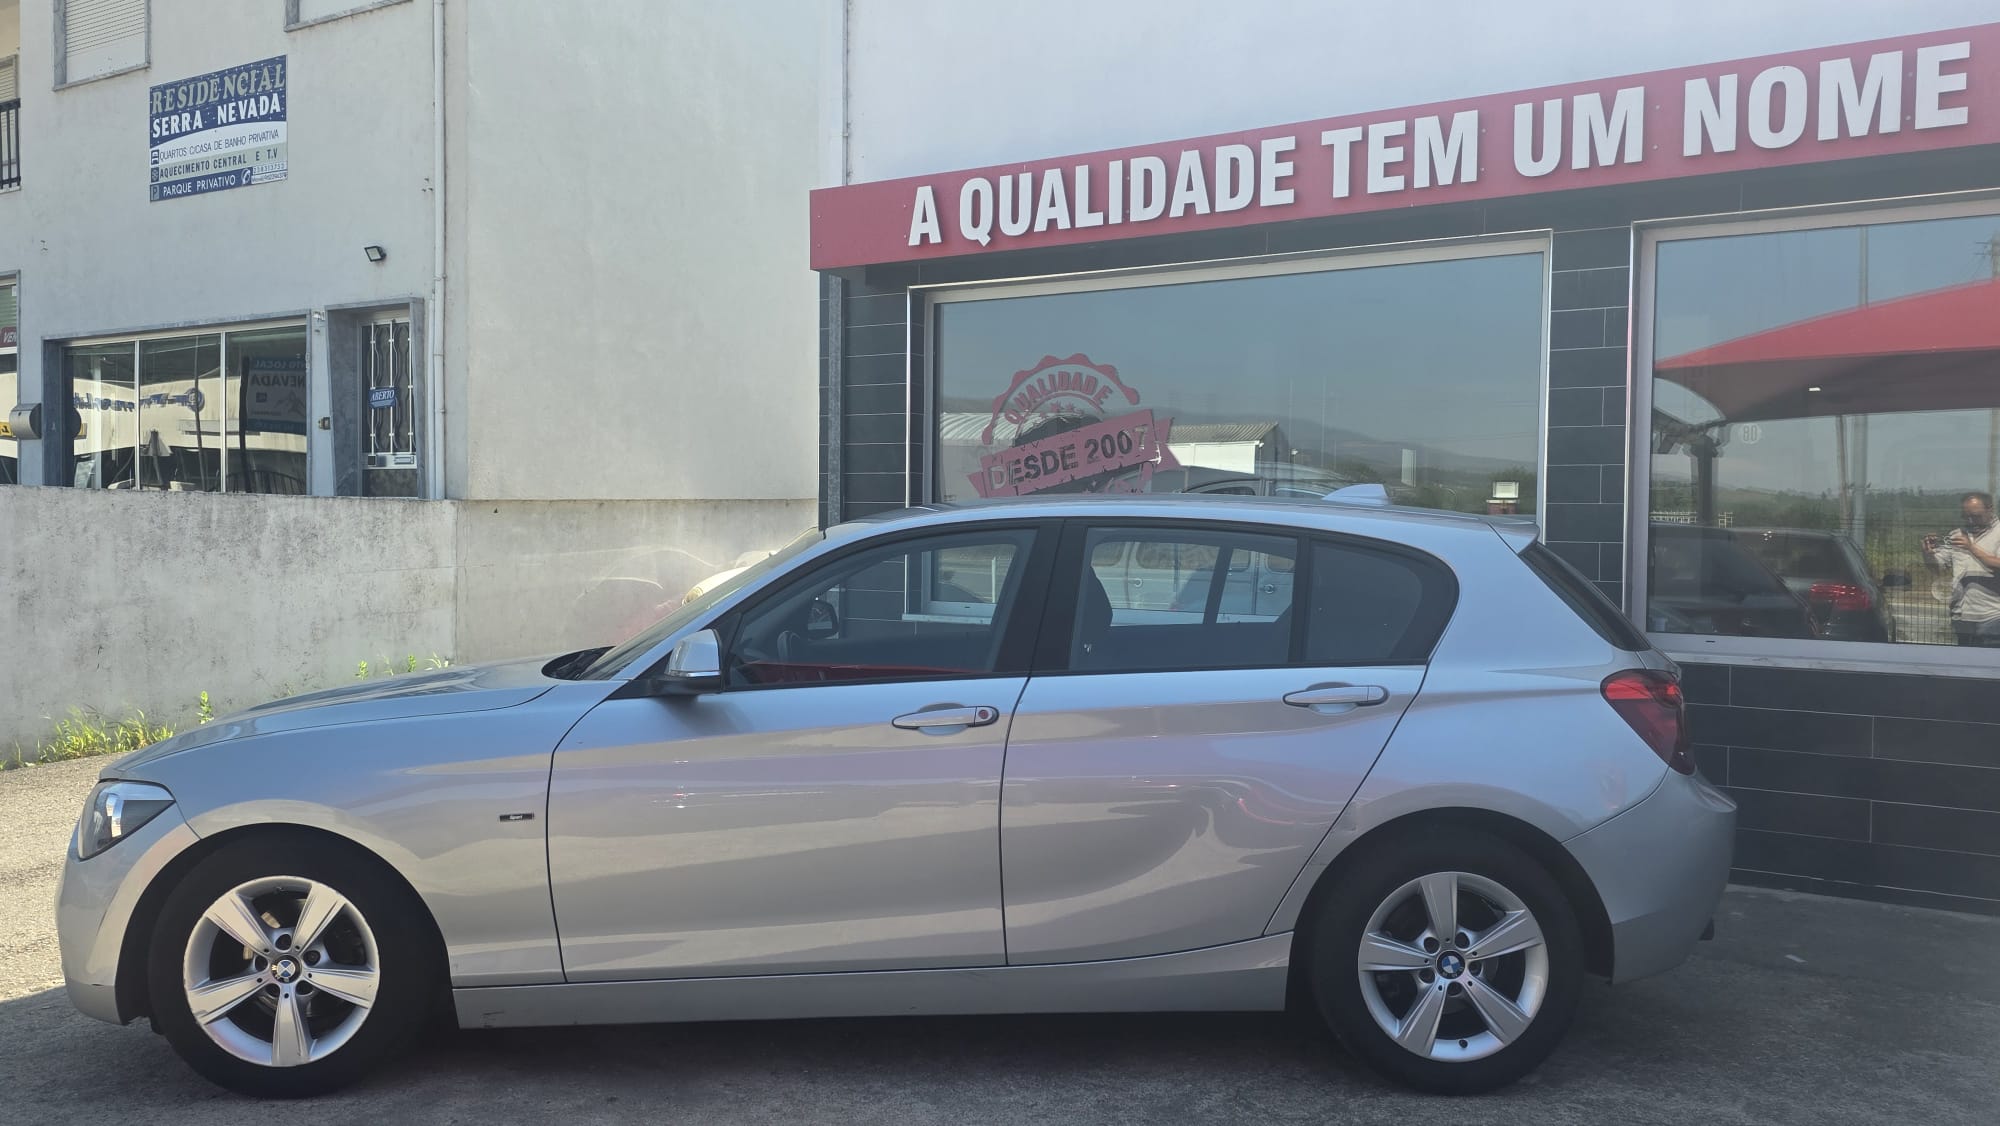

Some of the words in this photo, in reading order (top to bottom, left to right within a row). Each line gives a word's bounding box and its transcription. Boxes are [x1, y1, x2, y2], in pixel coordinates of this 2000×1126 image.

[152, 64, 285, 113] RESIDENCIAL
[152, 110, 203, 138] SERRA
[217, 93, 282, 125] NEVADA
[160, 147, 188, 161] QUARTOS
[214, 140, 223, 151] DE
[225, 136, 246, 149] BANHO
[248, 129, 279, 144] PRIVATIVA
[160, 161, 210, 179] AQUECIMENTO
[213, 152, 247, 169] CENTRAL
[255, 151, 260, 161] E
[908, 185, 942, 246] A
[959, 136, 1296, 246] QUALIDADE
[1321, 110, 1478, 199] TEM
[1513, 86, 1645, 178] UM
[1683, 41, 1971, 158] NOME
[163, 182, 192, 197] PARQUE
[197, 175, 236, 191] PRIVATIVO
[370, 389, 395, 402] ABERTO
[1005, 371, 1113, 424] QUALIDADE
[988, 444, 1078, 490] DESDE
[1084, 424, 1149, 465] 2007
